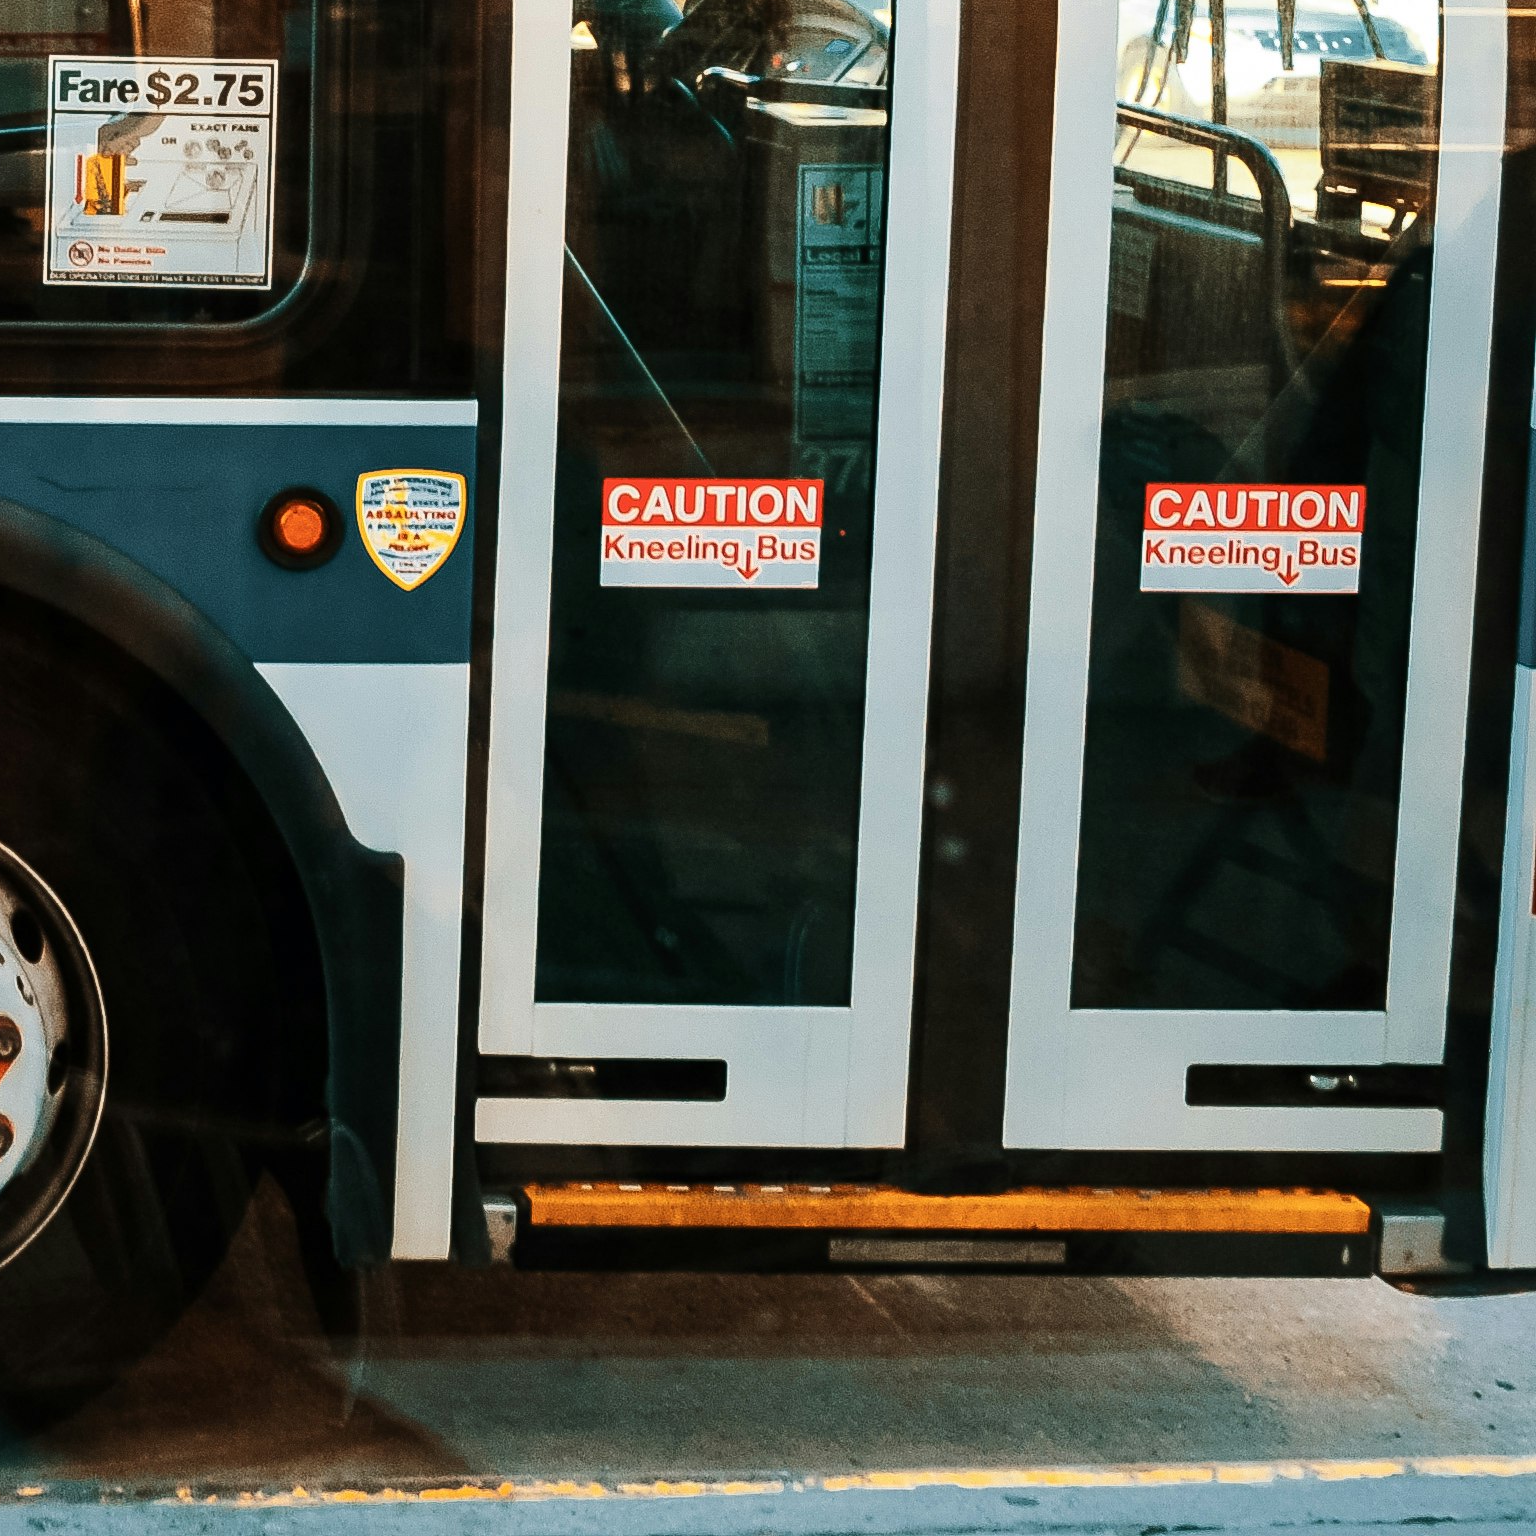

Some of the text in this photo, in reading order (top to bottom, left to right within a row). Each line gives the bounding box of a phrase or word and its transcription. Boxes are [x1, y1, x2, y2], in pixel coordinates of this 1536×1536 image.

[59, 67, 265, 111] Fare $2.75
[365, 509, 458, 521] ASSAULTING
[607, 484, 818, 524] CAUTION
[1149, 488, 1359, 529] CAUTION
[604, 533, 816, 567] Kneeling Bus
[1145, 538, 1358, 572] Kneeling Bus
